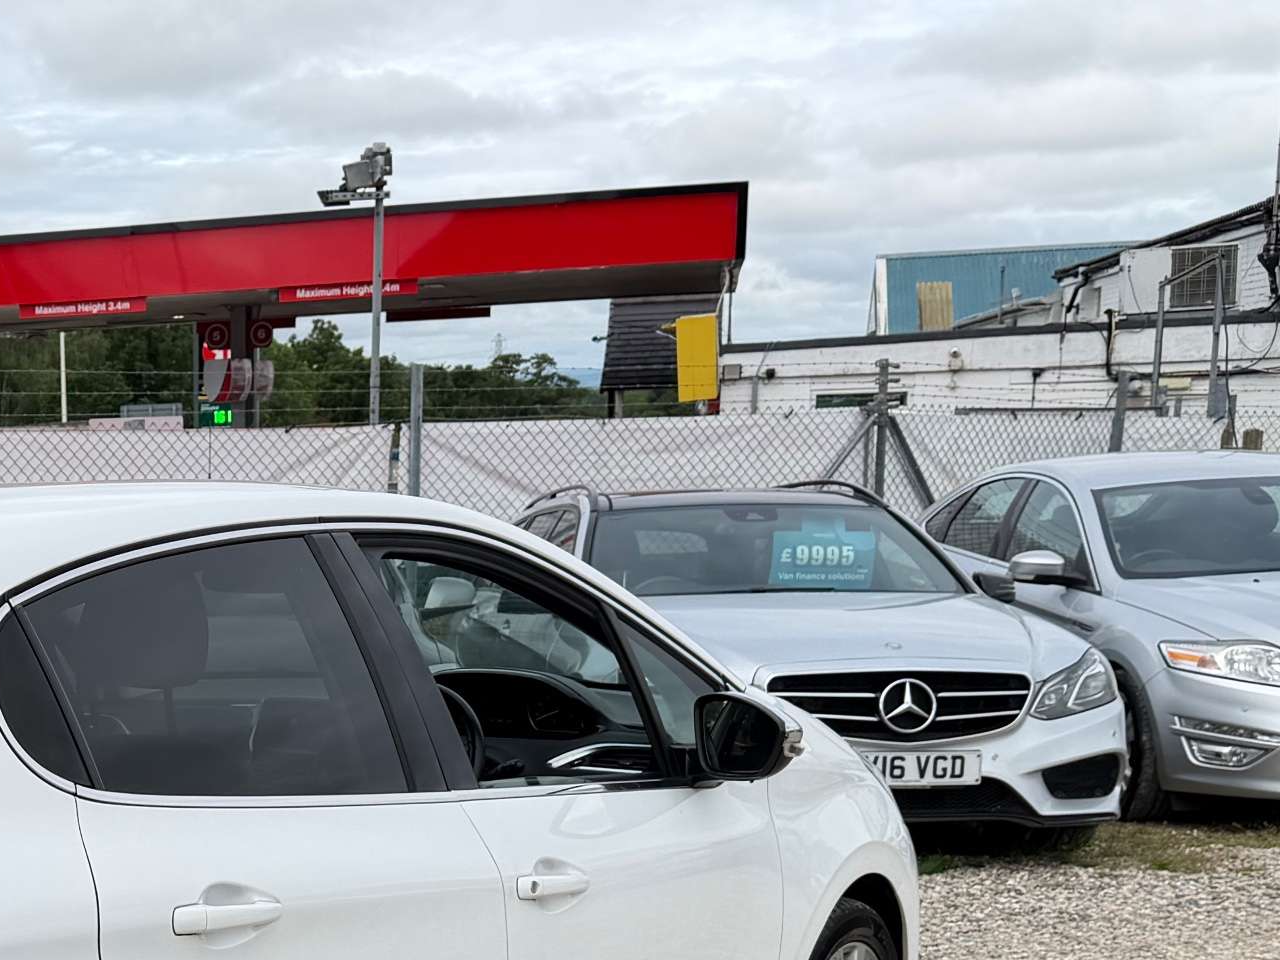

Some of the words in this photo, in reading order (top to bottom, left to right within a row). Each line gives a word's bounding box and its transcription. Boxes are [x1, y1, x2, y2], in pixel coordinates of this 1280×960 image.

[296, 288, 341, 299] Maximum
[35, 304, 77, 315] Maximum
[77, 302, 106, 314] Height
[107, 301, 130, 311] 3.4m
[778, 572, 793, 580] Van
[796, 572, 826, 580] finance
[827, 572, 865, 580] solutions
[916, 755, 965, 779] VGD
